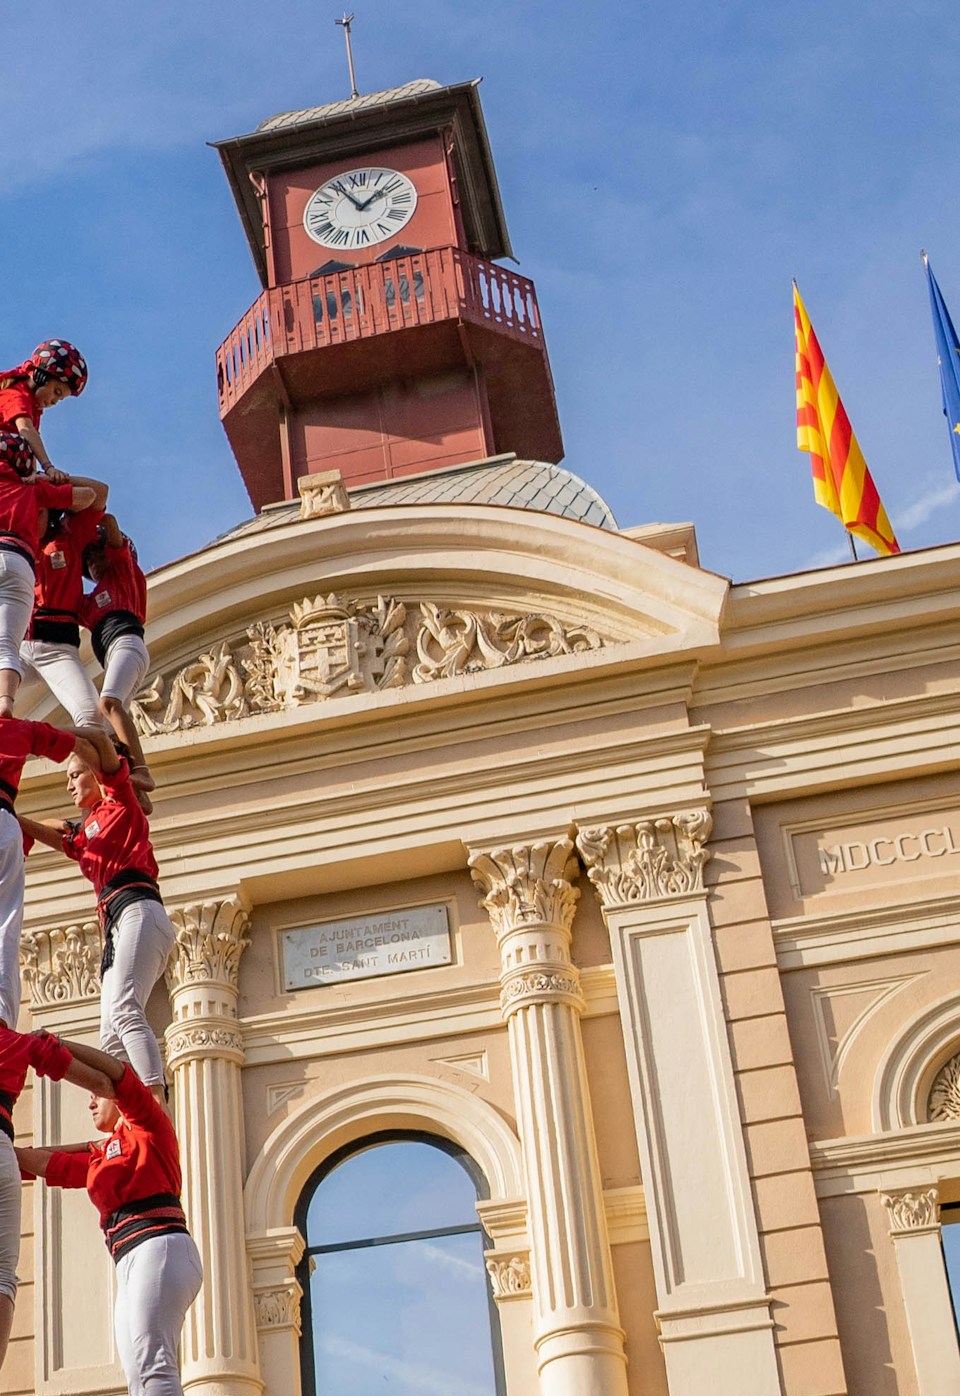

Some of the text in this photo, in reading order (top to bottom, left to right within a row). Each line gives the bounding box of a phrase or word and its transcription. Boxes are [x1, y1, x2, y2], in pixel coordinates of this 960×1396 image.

[310, 931, 421, 958] DE BARCELONA
[319, 919, 410, 943] AJUNTAMENT
[341, 956, 379, 972] SANT
[387, 944, 431, 965] MARTÍ
